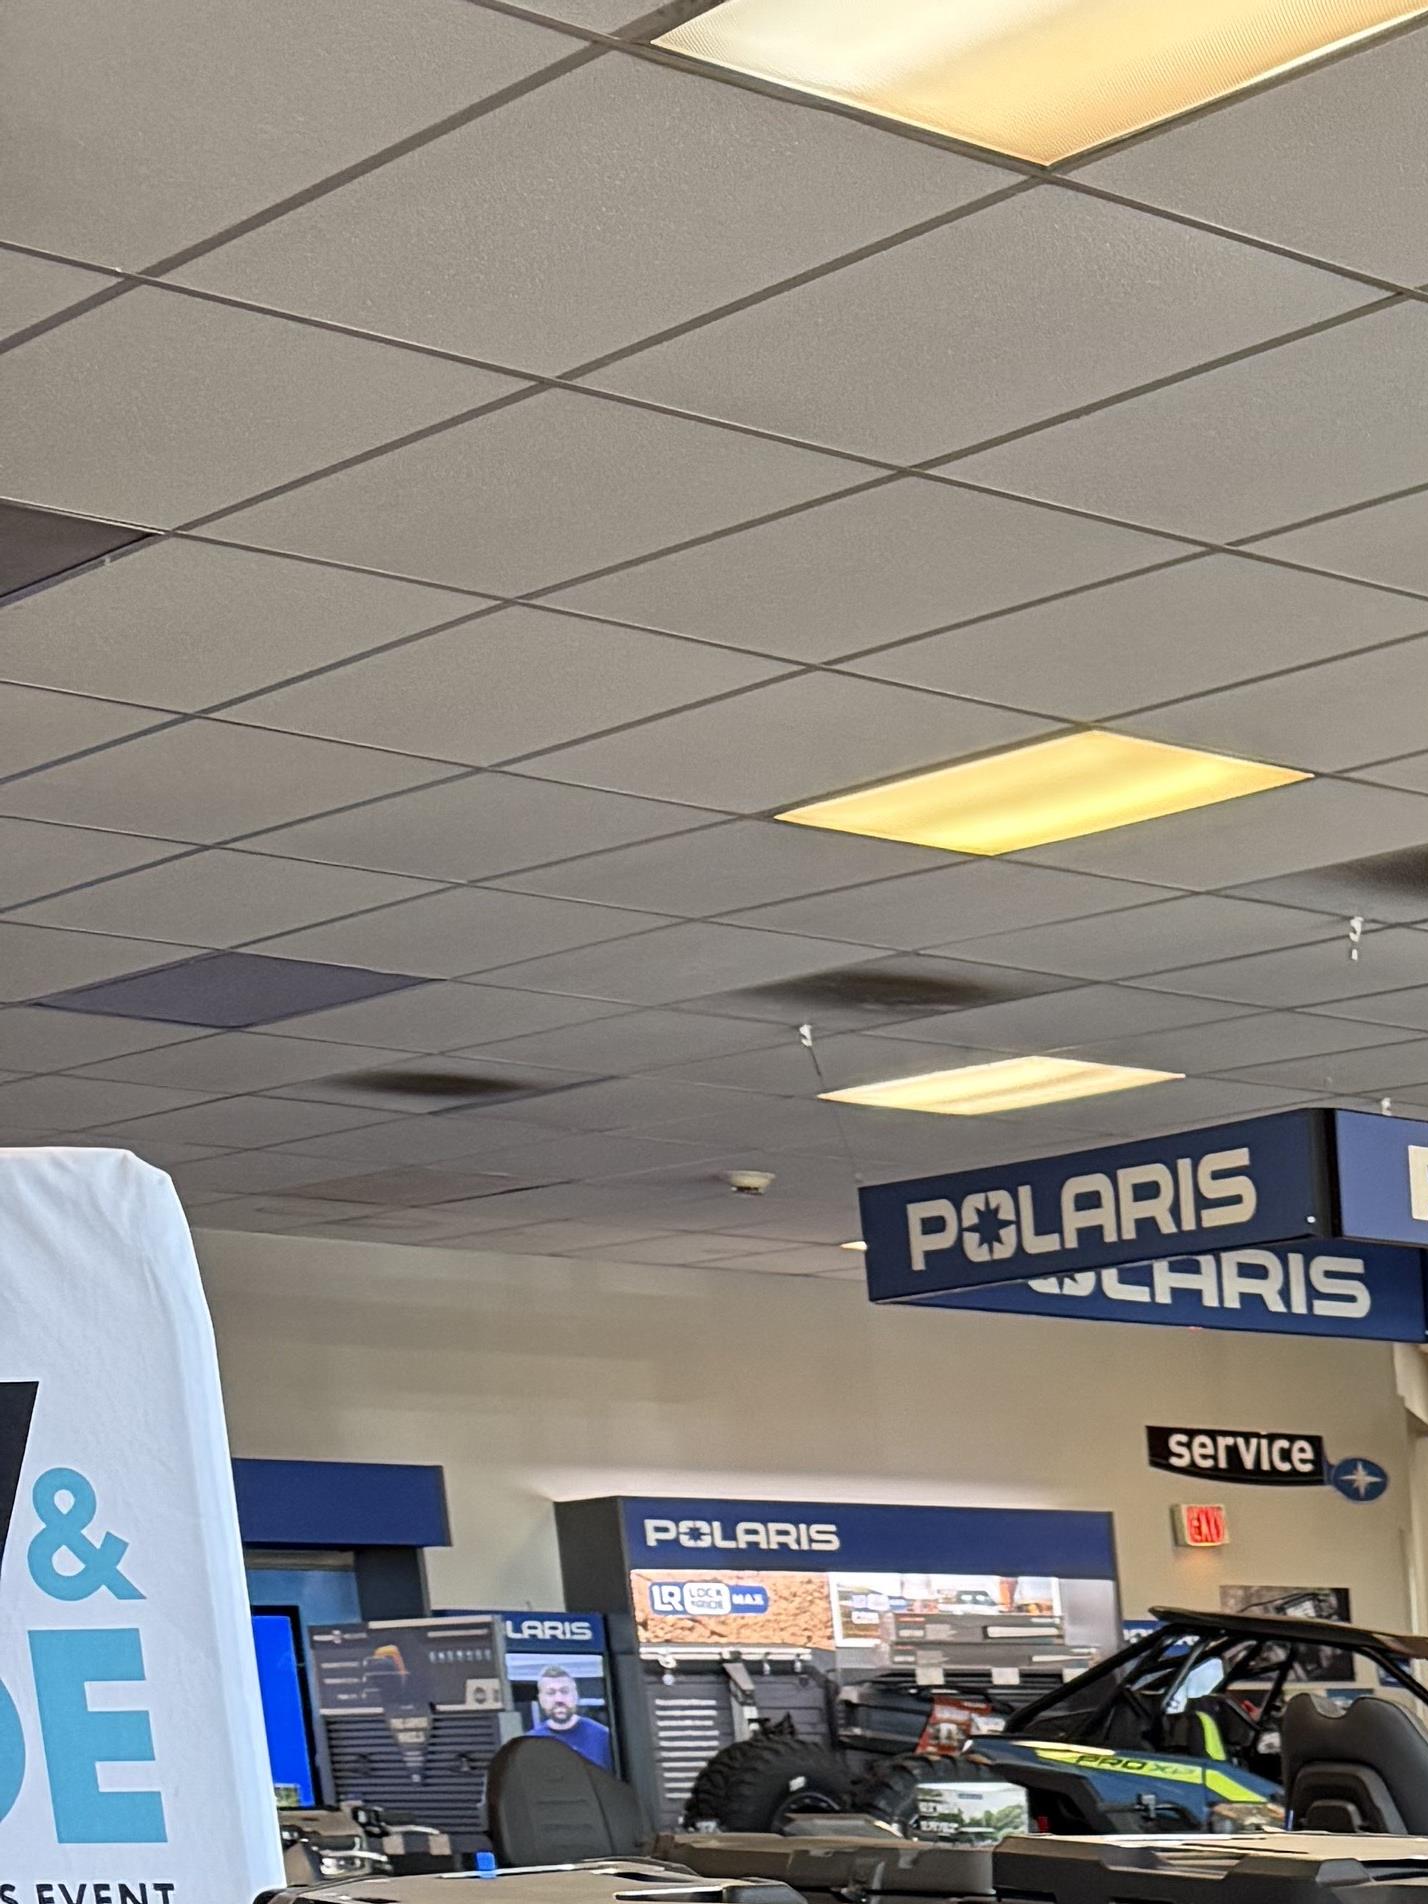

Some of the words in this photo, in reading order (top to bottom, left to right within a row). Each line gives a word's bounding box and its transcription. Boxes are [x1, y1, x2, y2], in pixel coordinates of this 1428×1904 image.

[906, 1147, 1257, 1271] POLARIS
[1028, 1249, 1371, 1318] LARIS
[1168, 1432, 1315, 1473] service
[27, 1467, 147, 1601] &
[643, 1518, 841, 1552] POLARIS
[505, 1620, 593, 1641] LARIS
[1076, 1753, 1148, 1772] PRO
